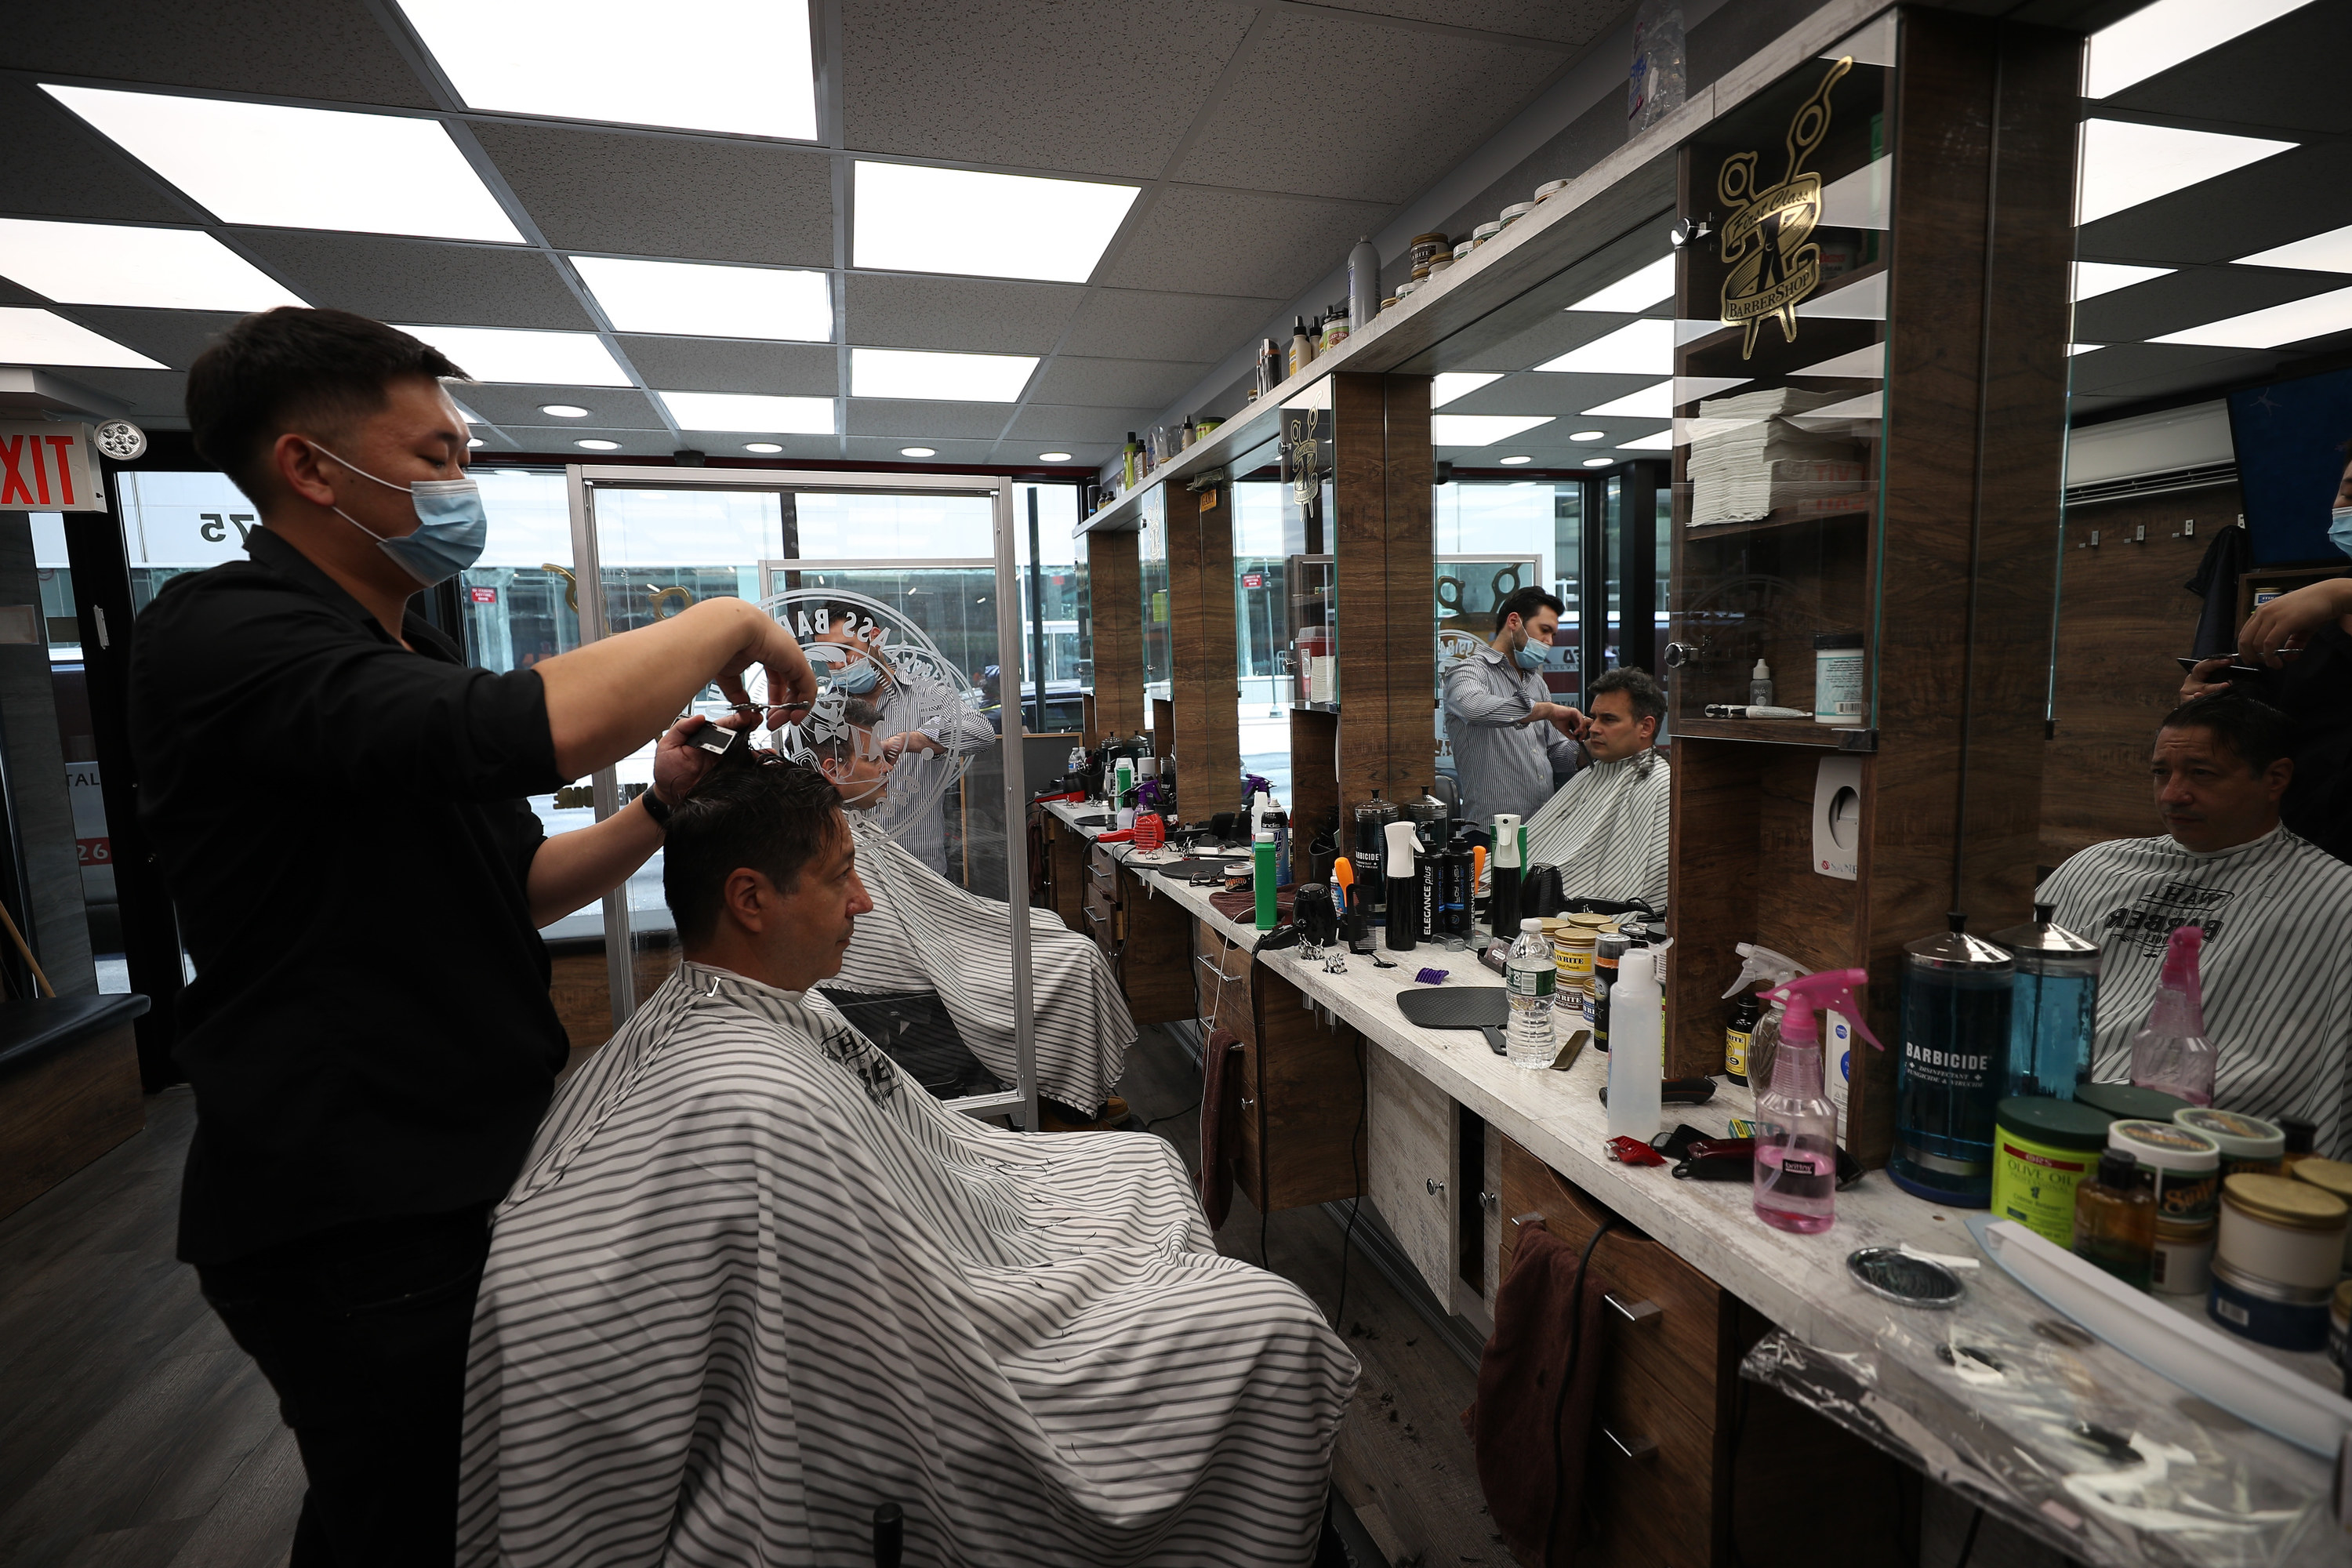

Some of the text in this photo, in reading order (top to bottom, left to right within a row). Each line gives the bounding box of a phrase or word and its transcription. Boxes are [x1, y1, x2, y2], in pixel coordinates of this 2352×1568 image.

[1733, 188, 1809, 236] First Class
[0, 435, 74, 504] XIT
[1424, 865, 1433, 885] plus
[1831, 862, 1857, 875] SANE
[1556, 954, 1584, 964] AYRITE
[1555, 993, 1582, 1004] AYRITE
[1906, 1041, 1988, 1070] BARBICIDE
[1919, 1065, 1969, 1080] DISINFECTANT
[2026, 1153, 2053, 1167] ORS
[2008, 1159, 2074, 1187] OLIVE OIL
